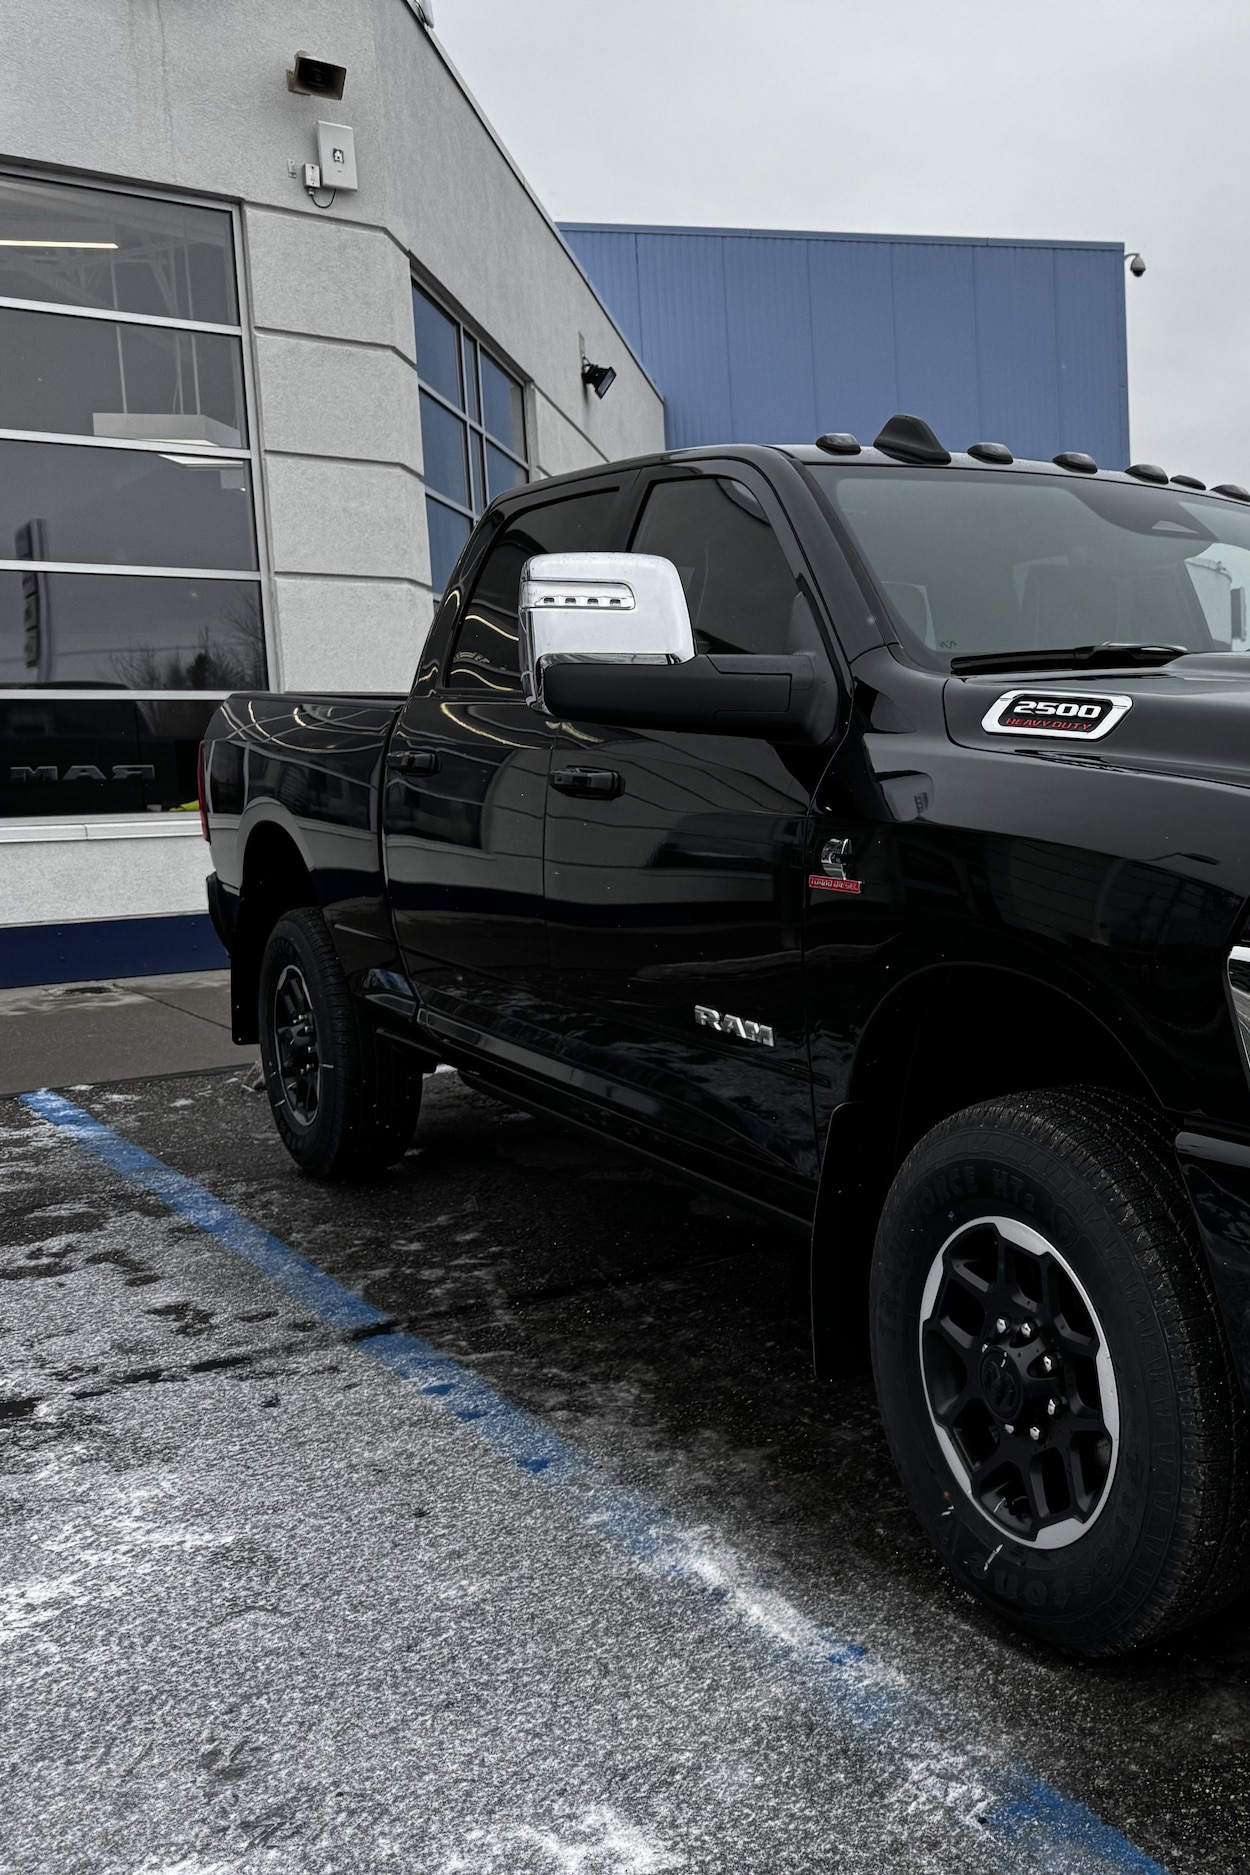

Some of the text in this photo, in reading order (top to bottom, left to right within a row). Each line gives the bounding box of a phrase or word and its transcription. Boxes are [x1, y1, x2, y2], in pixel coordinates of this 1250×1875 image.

[1013, 700, 1103, 718] 2500
[1005, 717, 1093, 731] HEAVY DUTY
[694, 1004, 776, 1048] RAM
